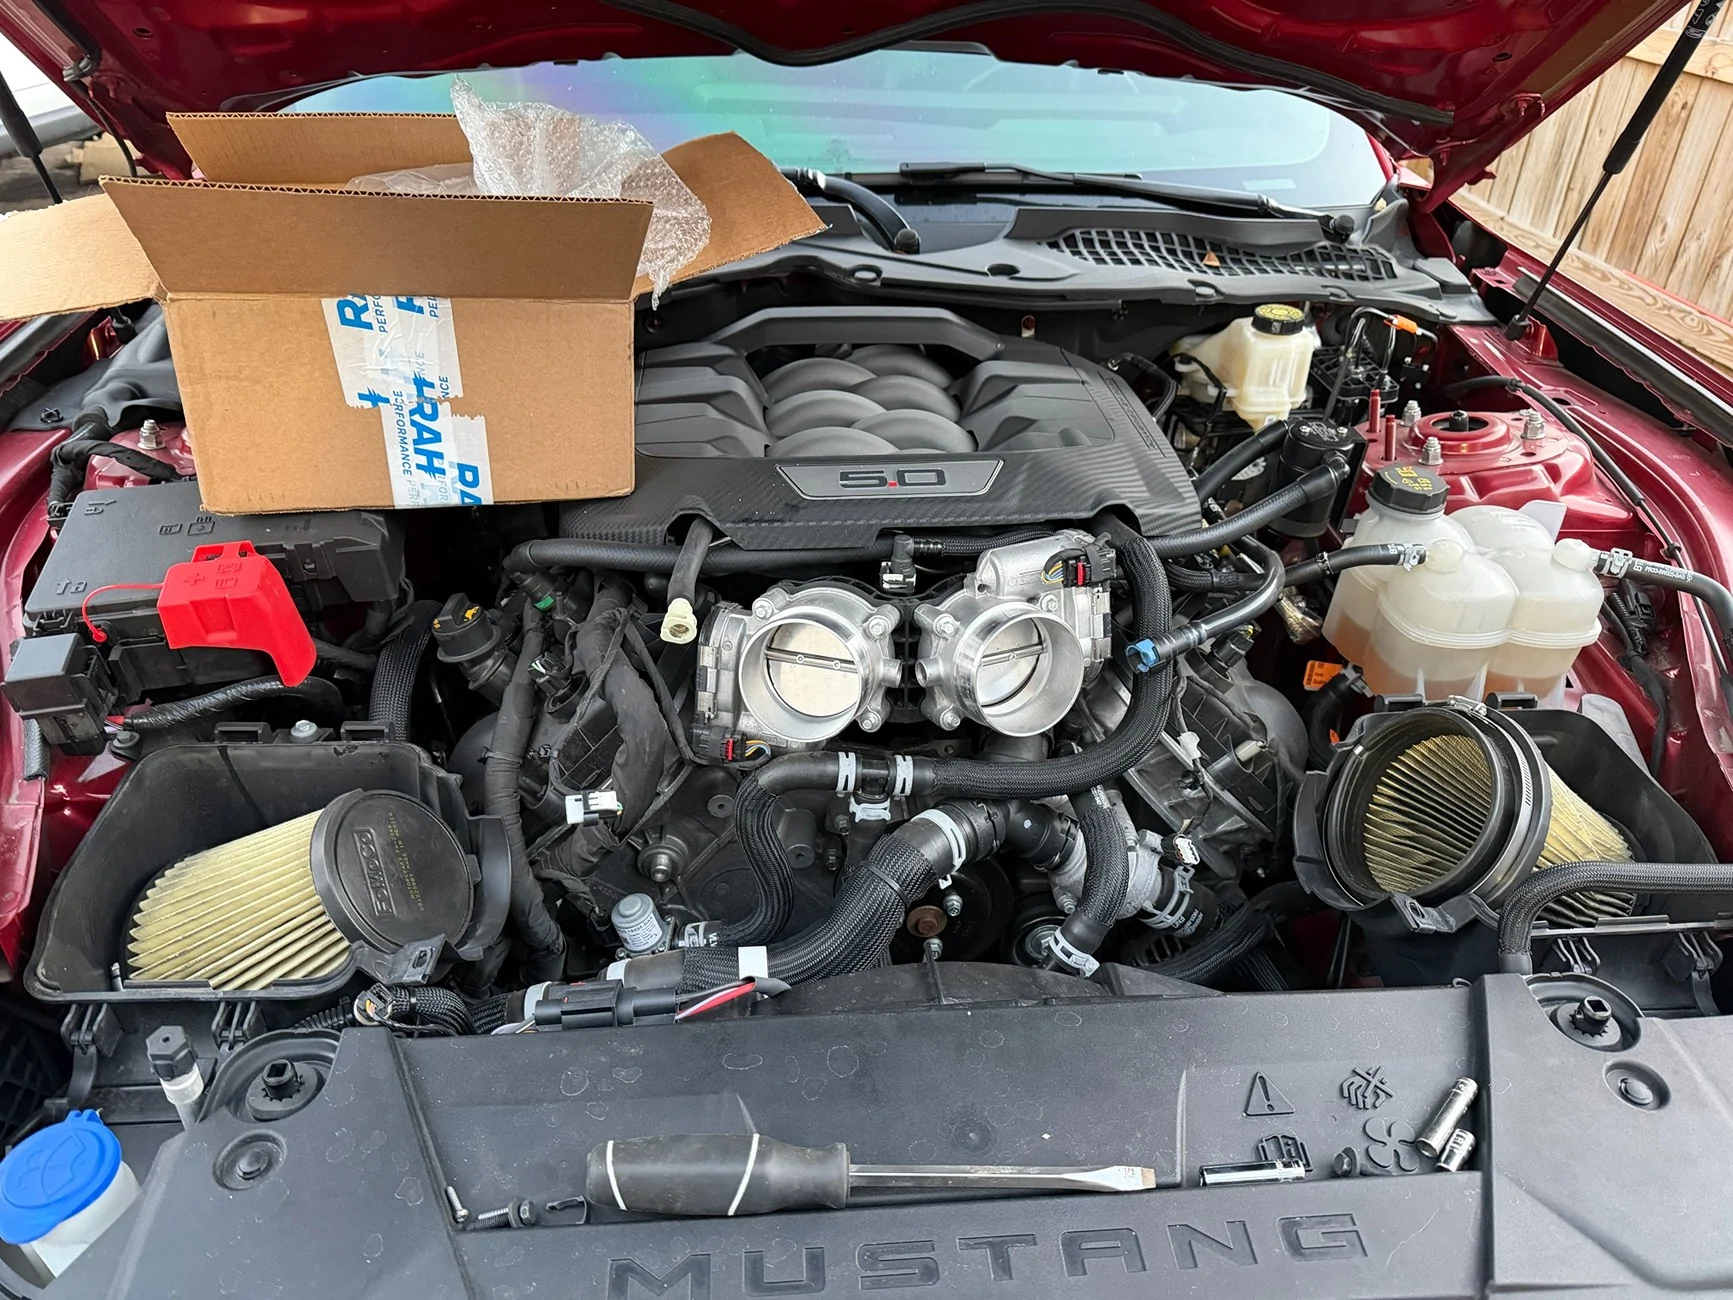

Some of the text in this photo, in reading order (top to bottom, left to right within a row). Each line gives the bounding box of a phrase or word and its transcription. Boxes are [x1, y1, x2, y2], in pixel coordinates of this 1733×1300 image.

[409, 401, 447, 480] RAH
[839, 468, 947, 489] 5.0
[606, 1212, 1368, 1300] MUSTANG
